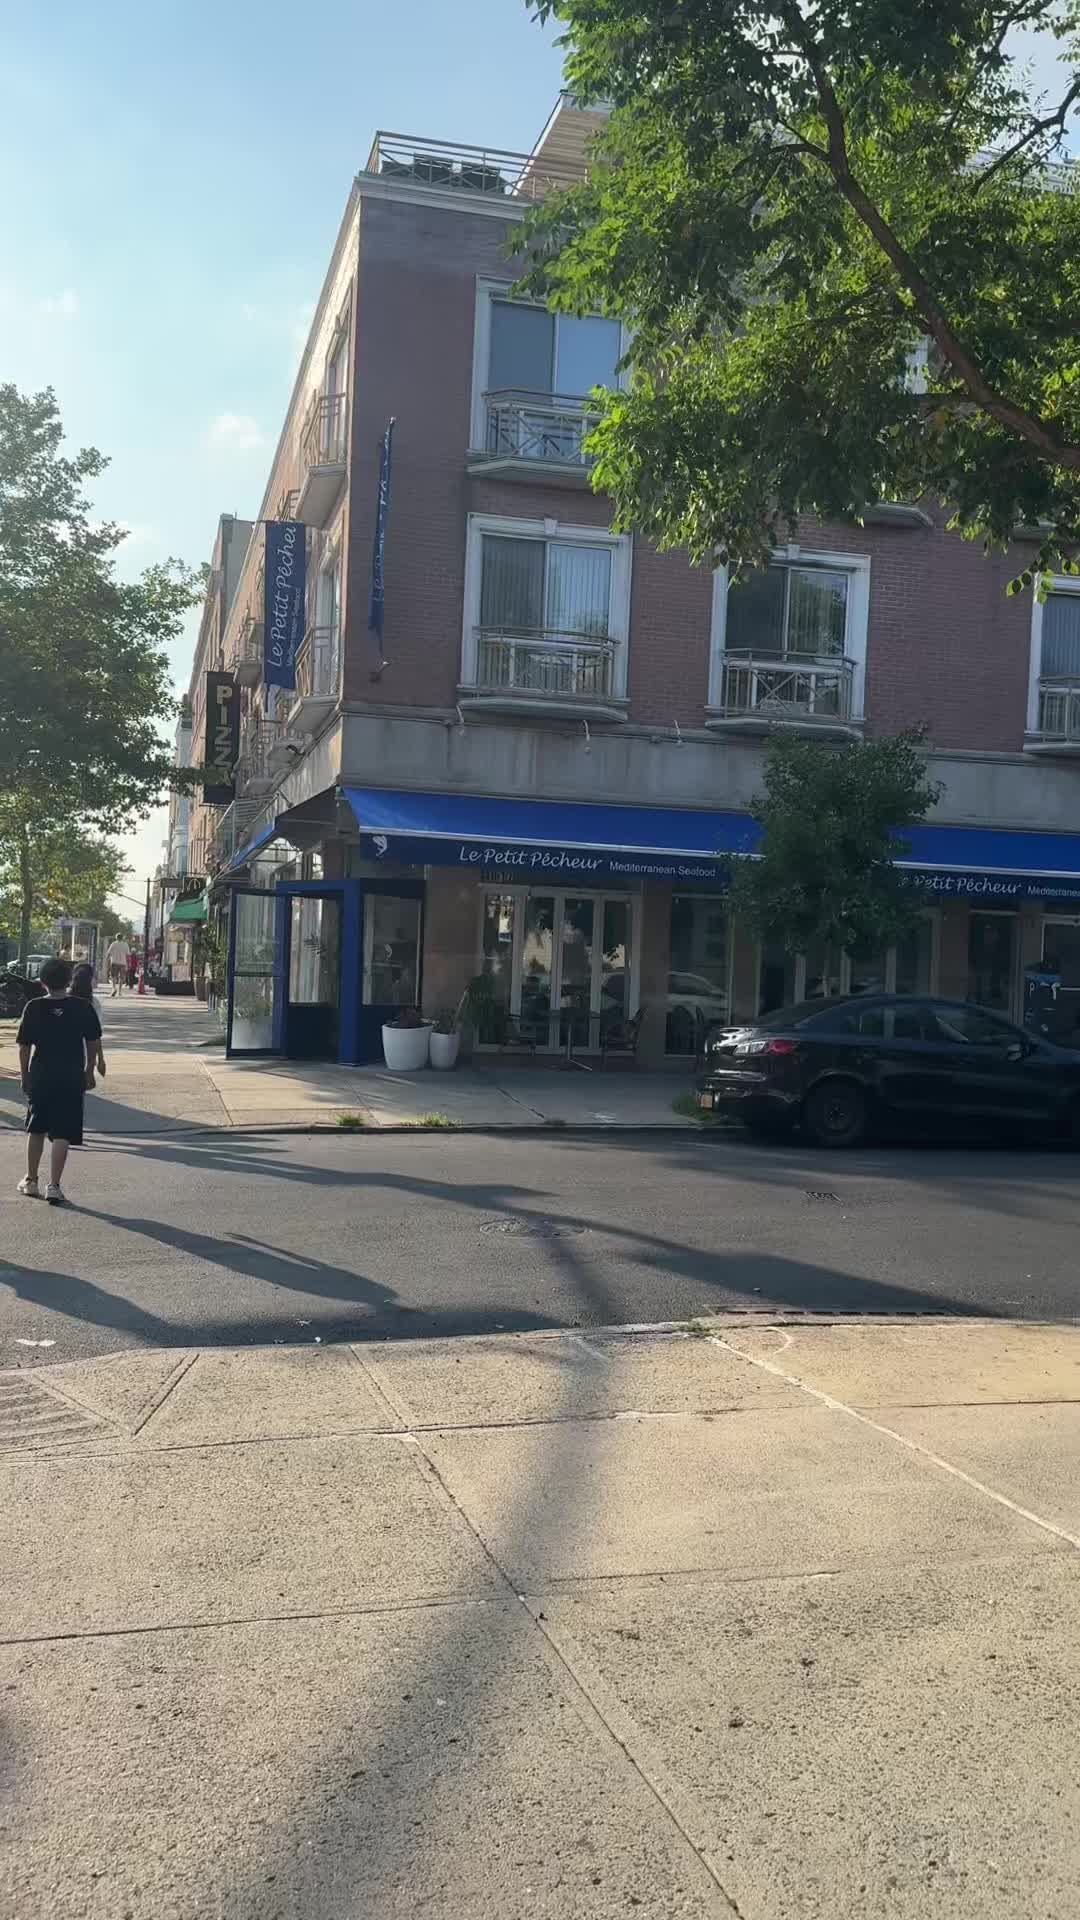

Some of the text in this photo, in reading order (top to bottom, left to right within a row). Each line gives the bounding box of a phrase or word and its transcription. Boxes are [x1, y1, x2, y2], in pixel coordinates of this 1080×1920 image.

[271, 590, 289, 640] Petit
[267, 642, 283, 667] Le
[460, 846, 716, 877] Le Petit Pêcheur Mediterranean Seafood
[957, 877, 1021, 893] Pêcheur
